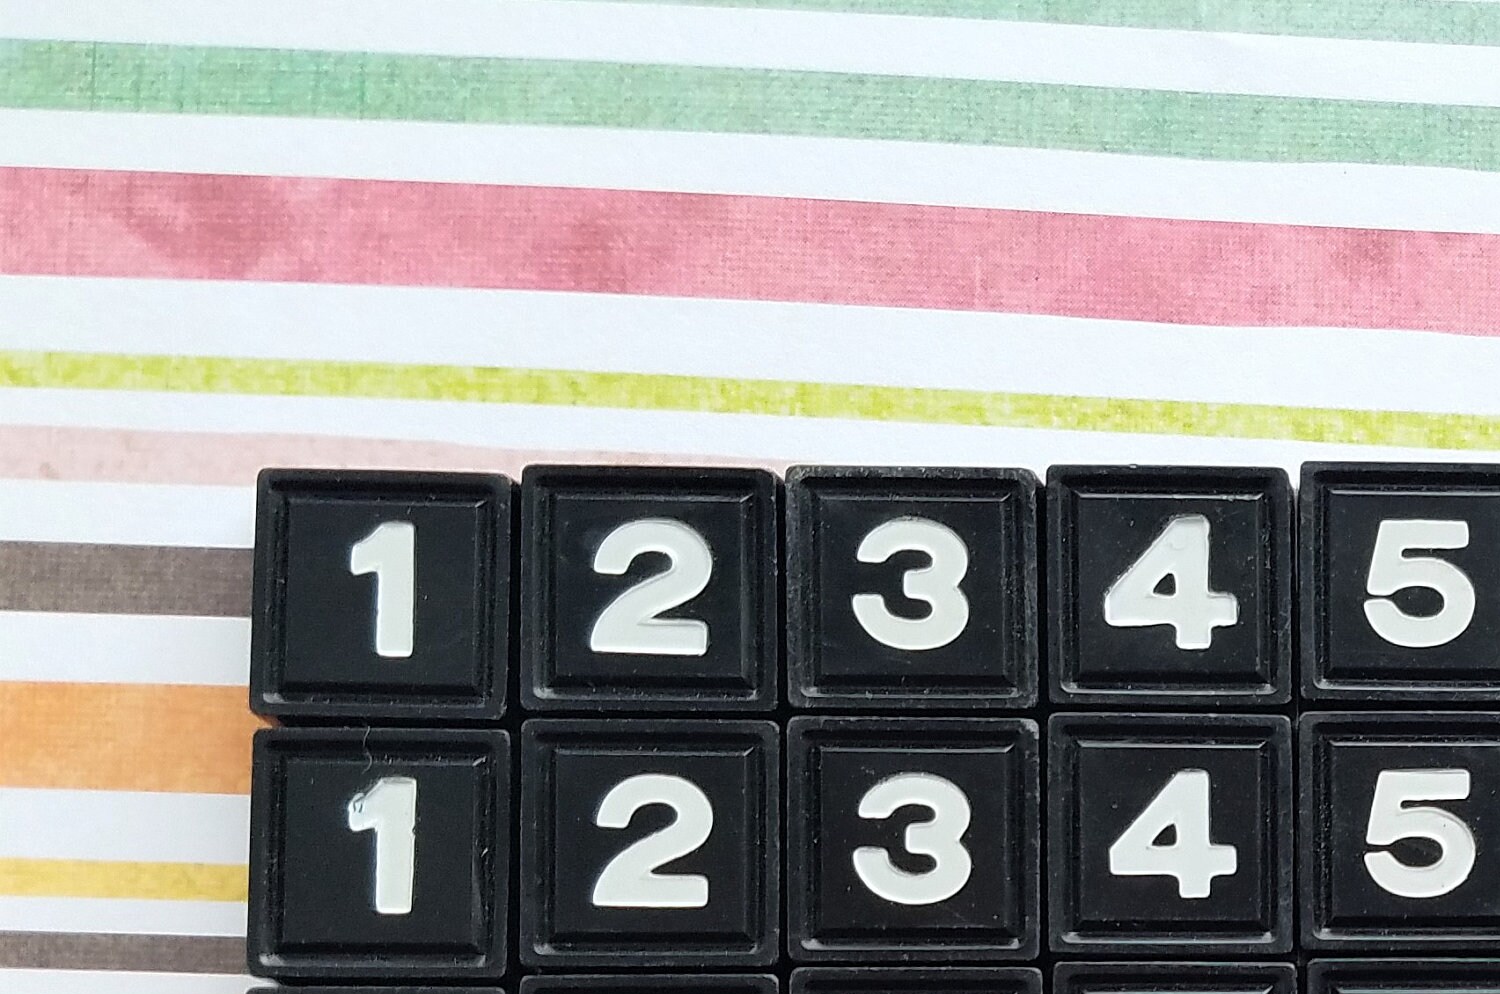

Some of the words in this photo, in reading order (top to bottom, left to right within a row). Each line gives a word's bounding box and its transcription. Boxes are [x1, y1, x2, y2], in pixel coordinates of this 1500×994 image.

[349, 521, 415, 658] 1
[589, 518, 713, 657] 2
[851, 515, 970, 651] 3
[1103, 514, 1238, 650] 4
[1363, 518, 1476, 648] 5
[346, 776, 417, 915] 1
[592, 773, 714, 908] 2
[852, 772, 972, 905] 3
[1108, 770, 1238, 899] 4
[1363, 768, 1476, 898] 5
